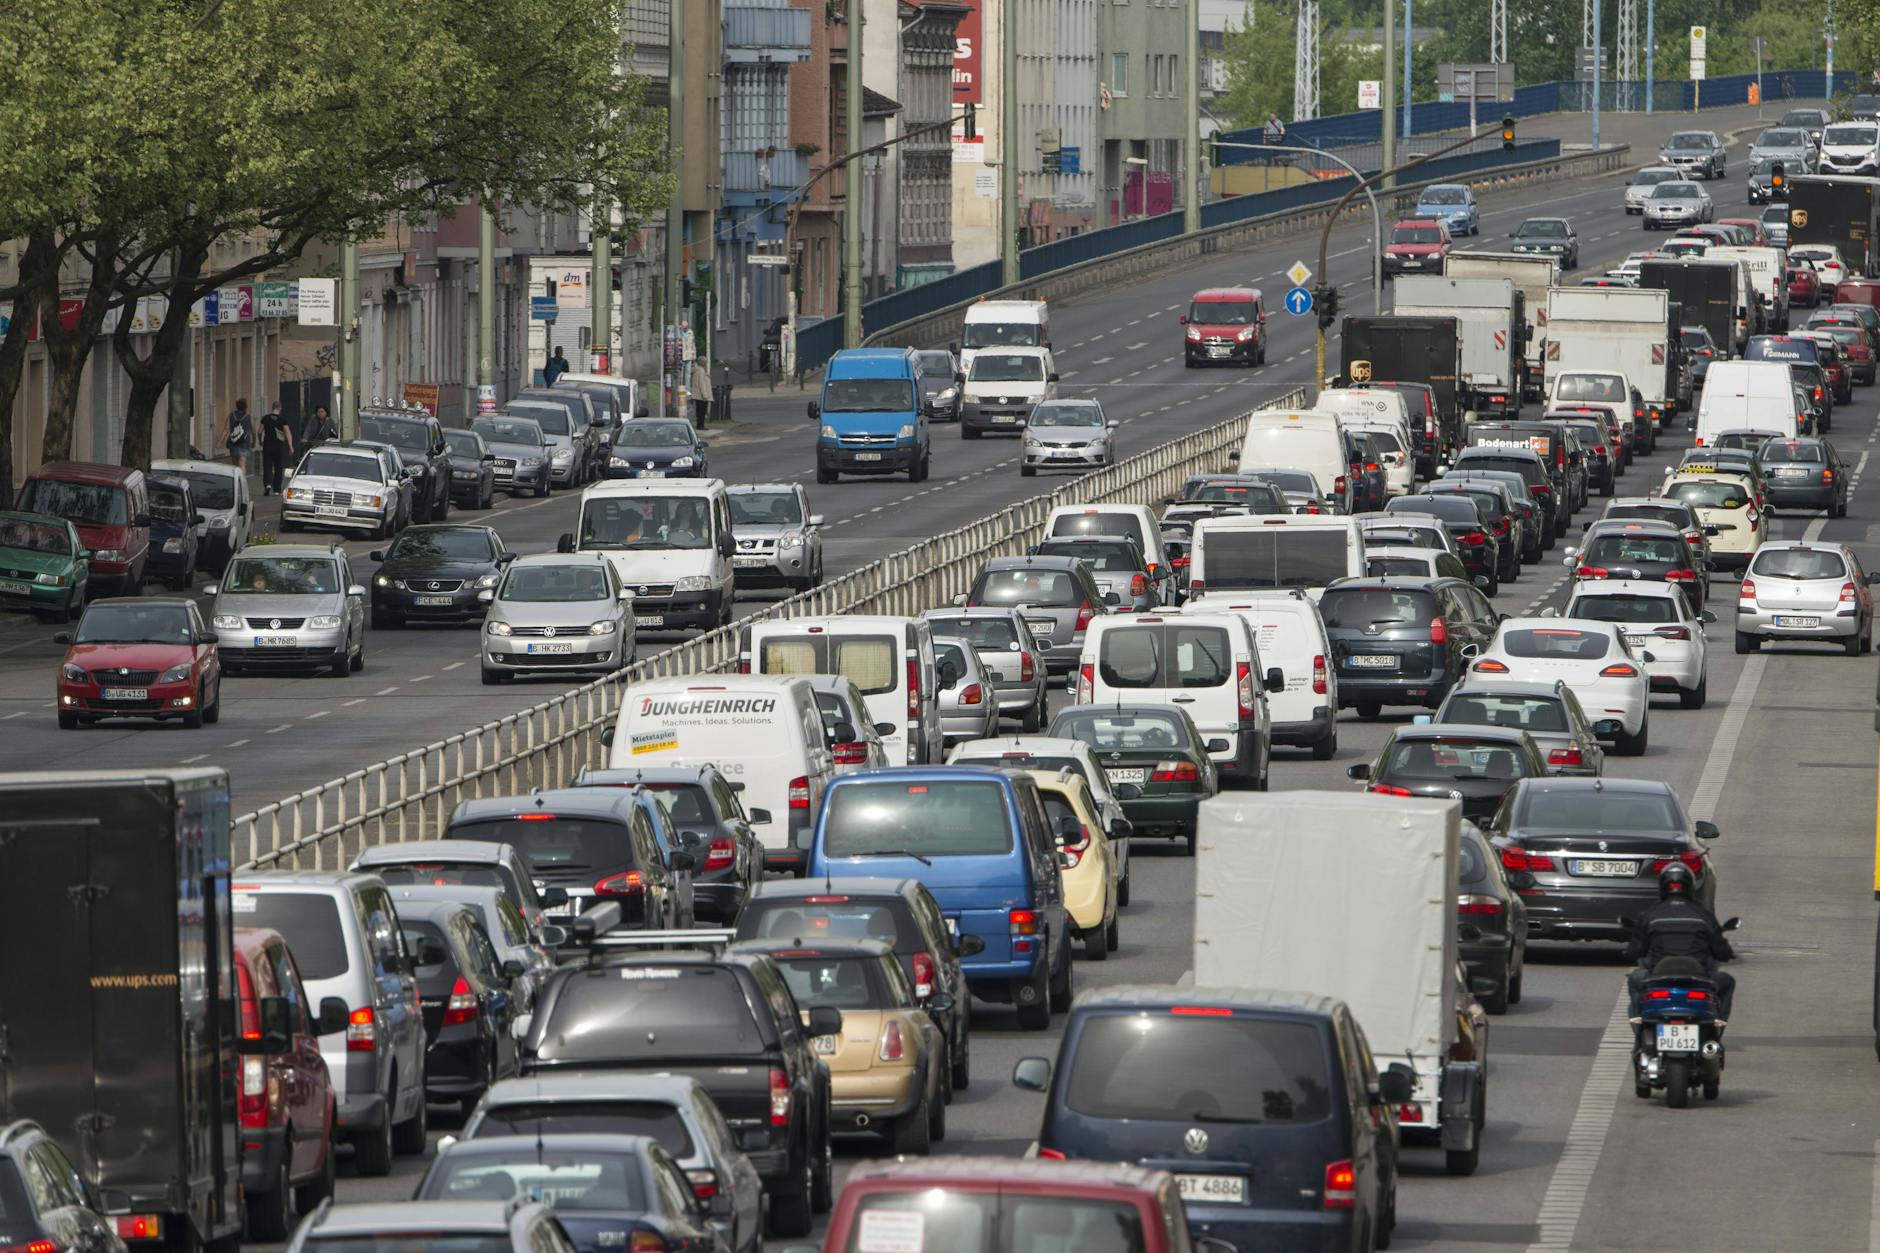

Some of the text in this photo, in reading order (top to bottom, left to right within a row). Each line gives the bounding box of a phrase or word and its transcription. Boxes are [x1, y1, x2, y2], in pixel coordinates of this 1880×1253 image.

[563, 272, 580, 283] dm
[1351, 366, 1371, 381] ups
[541, 645, 551, 653] HK
[552, 645, 571, 653] 2733
[1374, 656, 1394, 665] 5018
[640, 698, 776, 717] JUNGHEINRICH
[662, 716, 774, 727] Machines. Ideas. Solutions.
[632, 730, 675, 744] Mietstapler
[1121, 769, 1143, 779] 1325
[1578, 862, 1634, 874] B SB 7004
[89, 973, 177, 989] www.ups.com
[1671, 1027, 1679, 1036] B
[1660, 1038, 1697, 1049] PU 612
[1202, 1179, 1240, 1195] 4886
